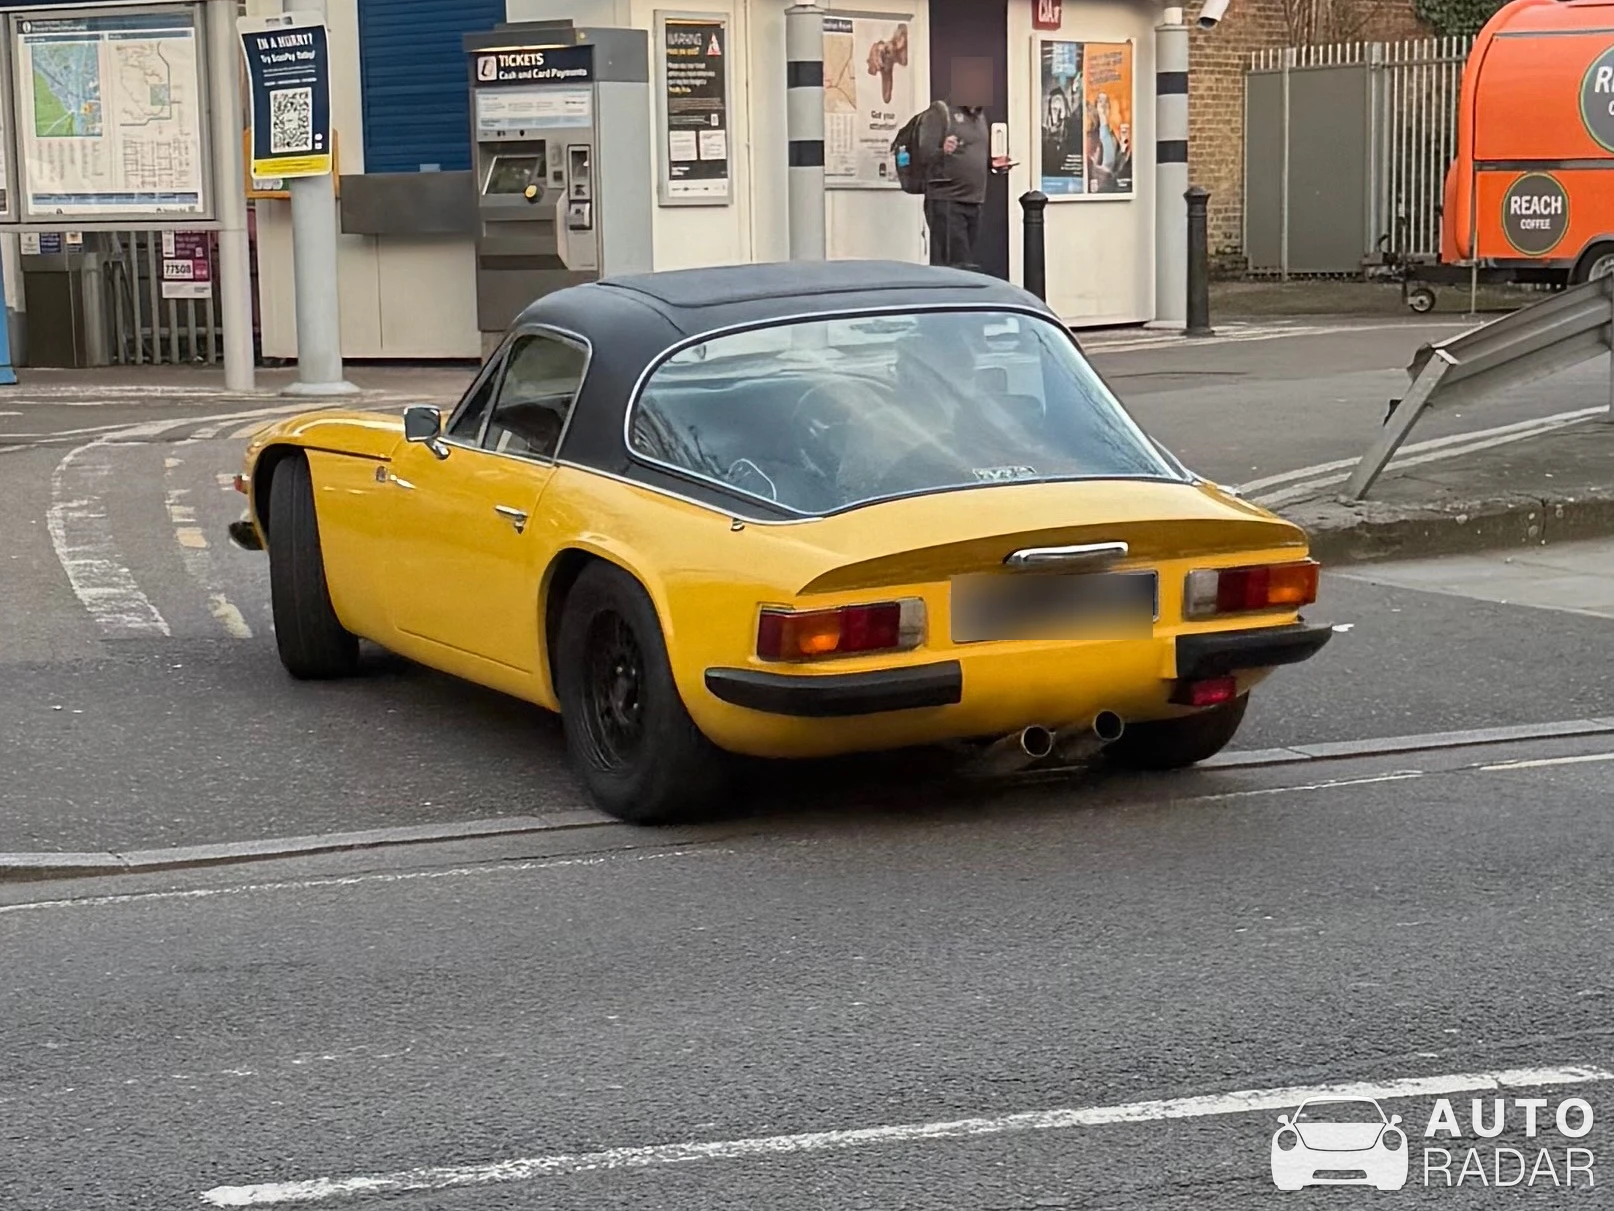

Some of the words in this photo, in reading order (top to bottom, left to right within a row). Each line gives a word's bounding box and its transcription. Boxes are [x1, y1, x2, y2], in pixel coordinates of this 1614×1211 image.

[270, 37, 278, 49] A
[499, 53, 544, 67] TICKETS
[499, 71, 517, 80] Cash
[518, 70, 532, 79] and
[533, 68, 550, 78] Card
[551, 68, 588, 79] Payments
[1594, 65, 1614, 93] R
[1510, 195, 1562, 215] REACH
[1520, 218, 1551, 230] COFFEE
